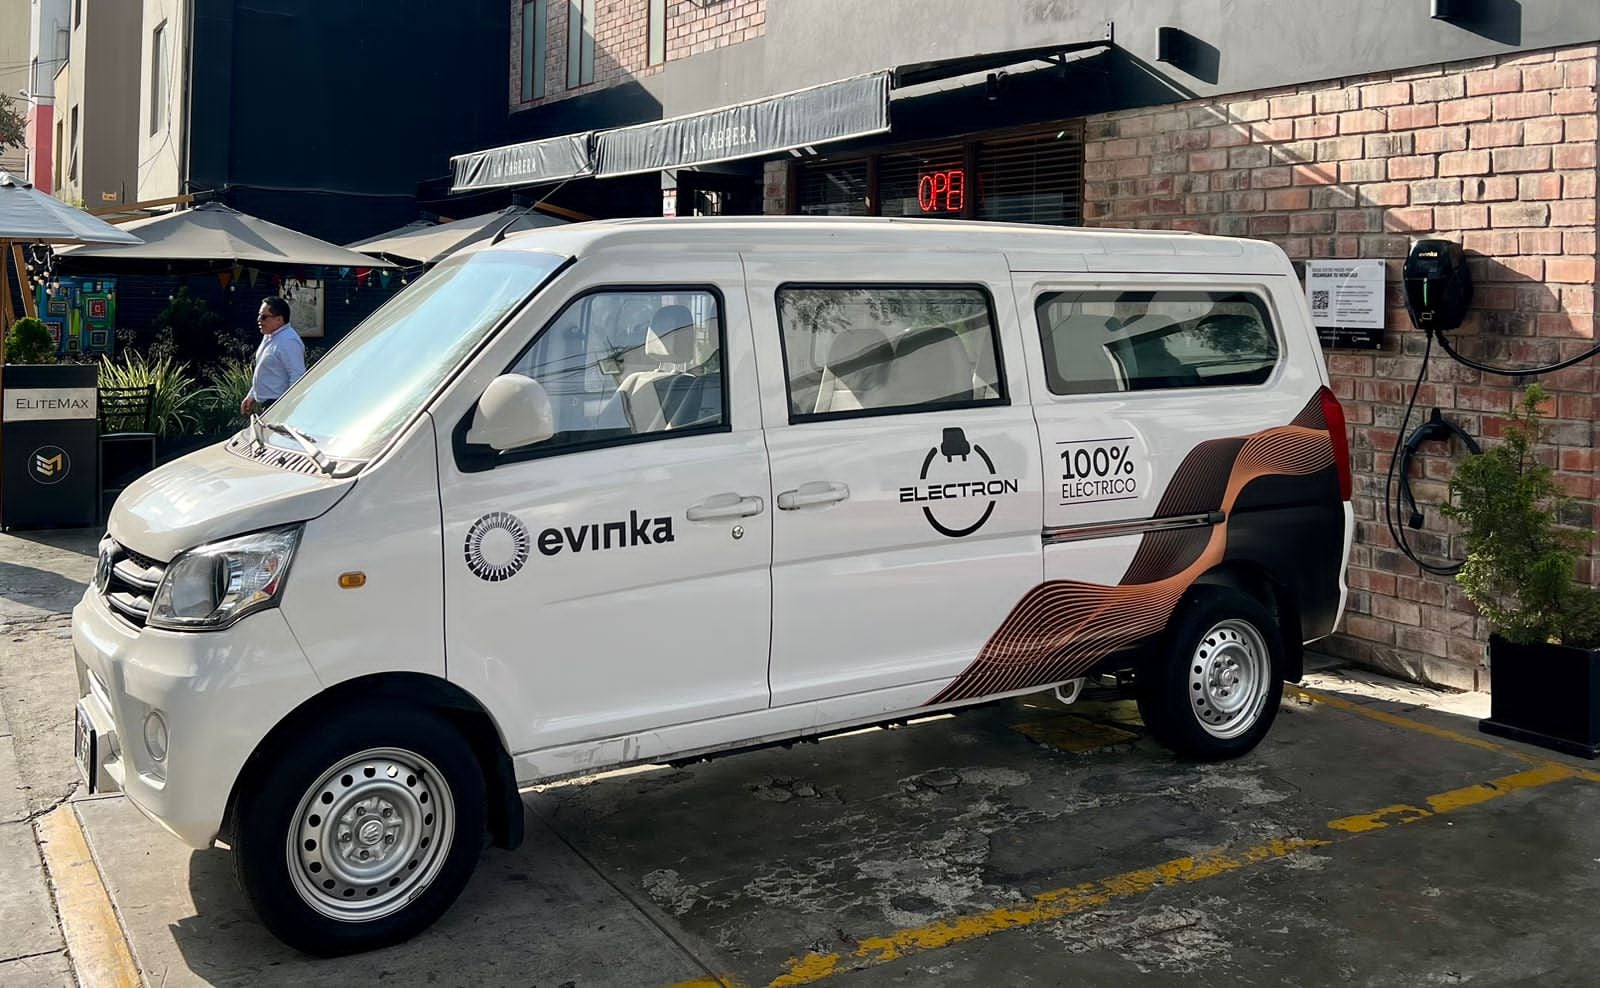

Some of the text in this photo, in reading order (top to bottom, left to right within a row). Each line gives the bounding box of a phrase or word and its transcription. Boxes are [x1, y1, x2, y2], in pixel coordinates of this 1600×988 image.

[682, 123, 757, 154] LA CABRERA
[919, 171, 964, 211] OPE
[1060, 446, 1134, 479] 100%
[899, 479, 1018, 502] ELECTRON
[1062, 478, 1136, 498] ELÉCTRICO
[537, 509, 675, 556] evinka
